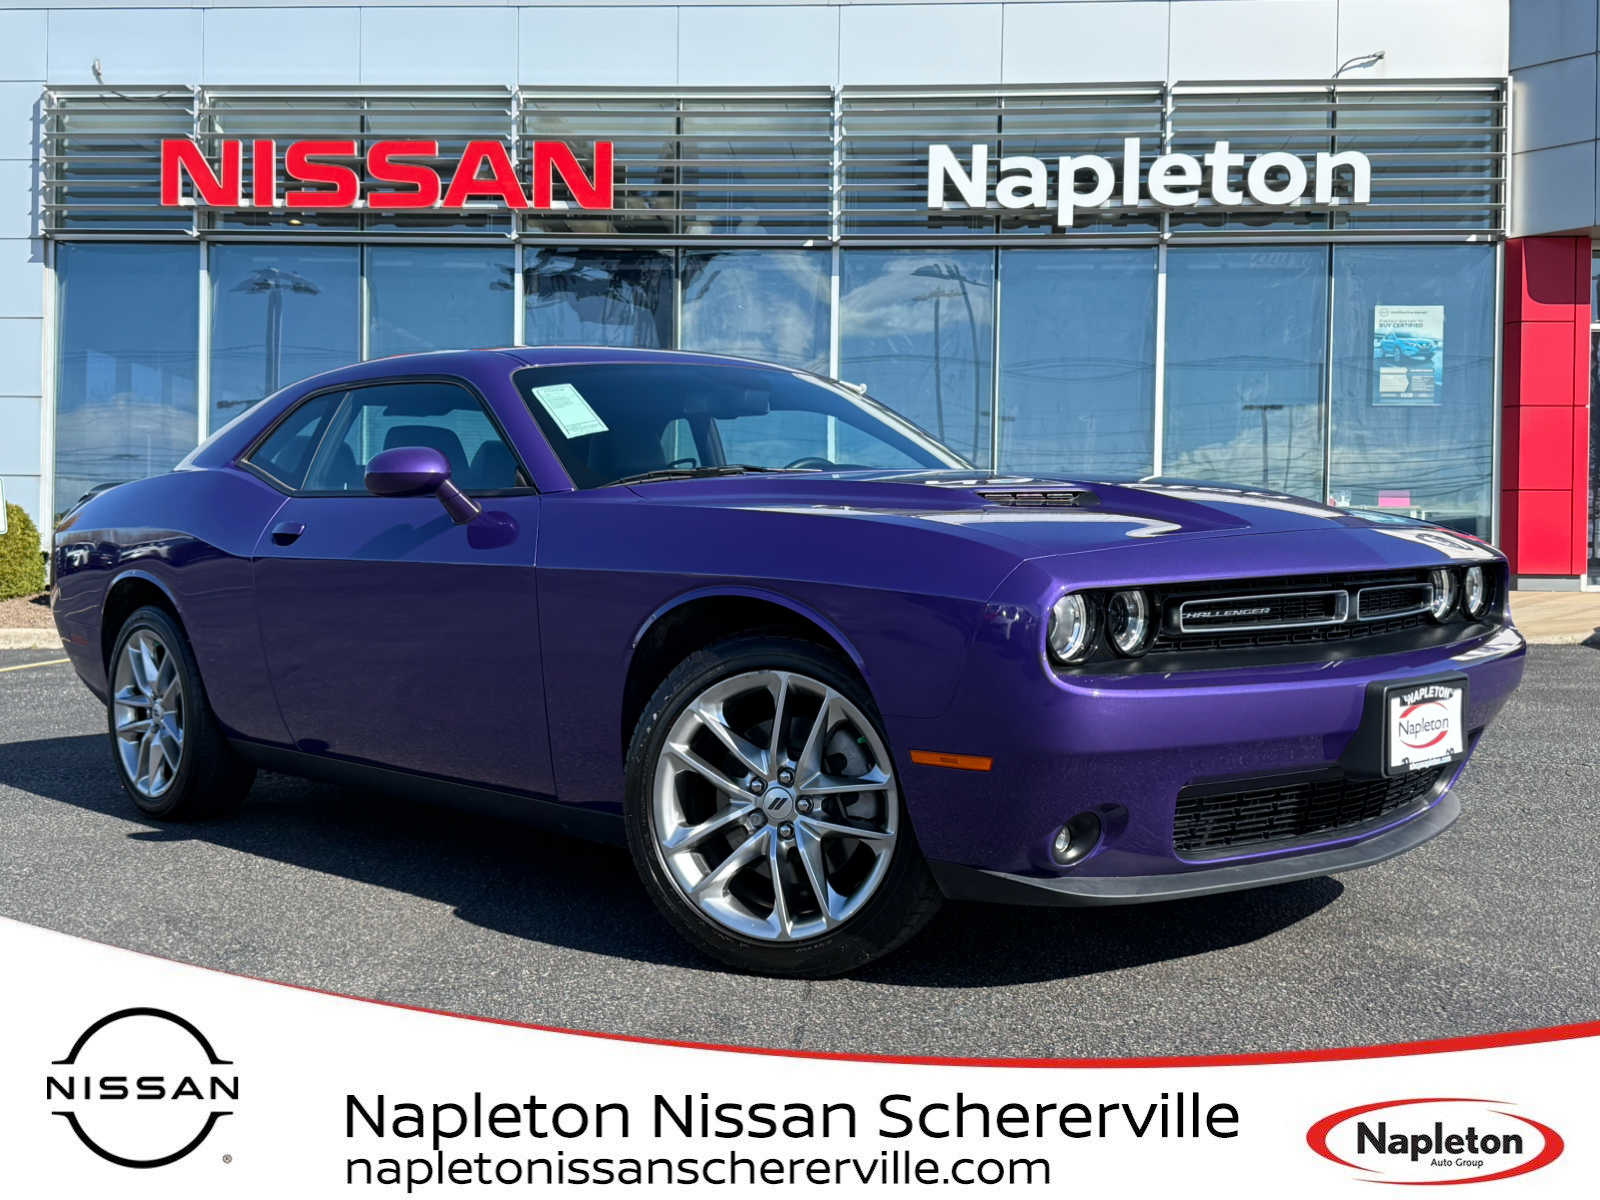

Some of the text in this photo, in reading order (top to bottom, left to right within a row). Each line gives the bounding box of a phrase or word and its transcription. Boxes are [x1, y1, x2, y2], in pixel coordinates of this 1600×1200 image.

[161, 138, 613, 210] NISSAN
[927, 136, 1371, 226] Napleton
[1180, 607, 1271, 619] CHALLENGER
[1398, 717, 1449, 740] Napleton
